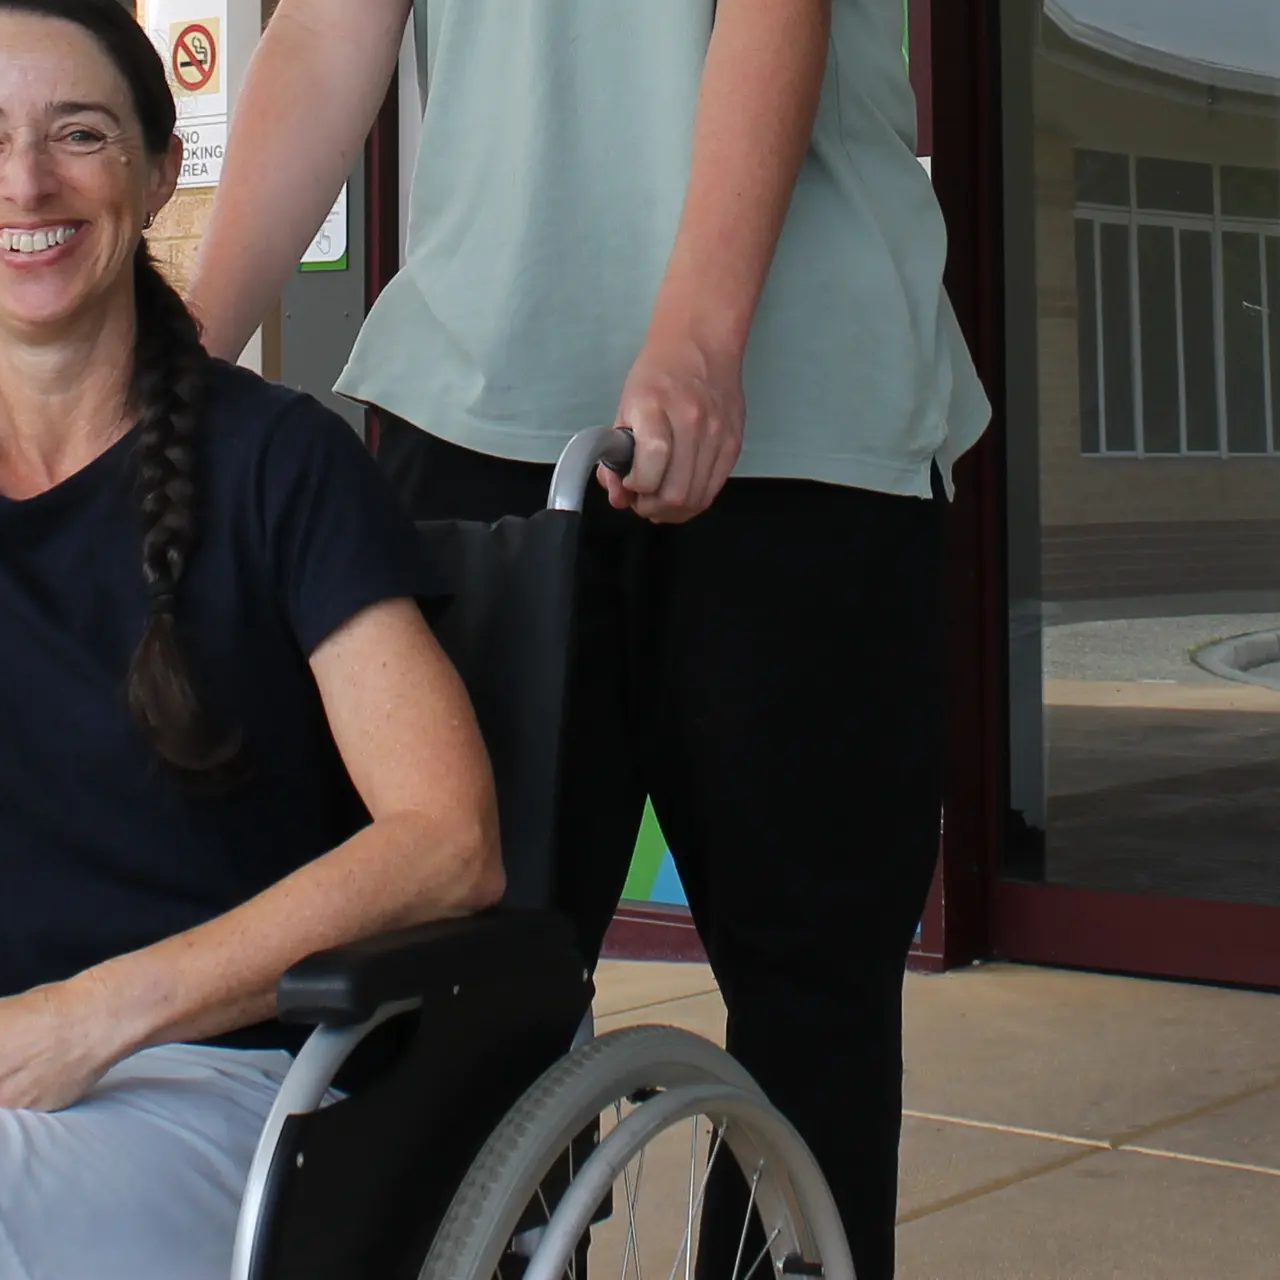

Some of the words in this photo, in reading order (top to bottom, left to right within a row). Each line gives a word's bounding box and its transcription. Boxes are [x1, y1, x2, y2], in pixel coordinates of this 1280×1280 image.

[181, 131, 200, 144] NO
[183, 144, 223, 161] OKING
[181, 163, 209, 177] REA
